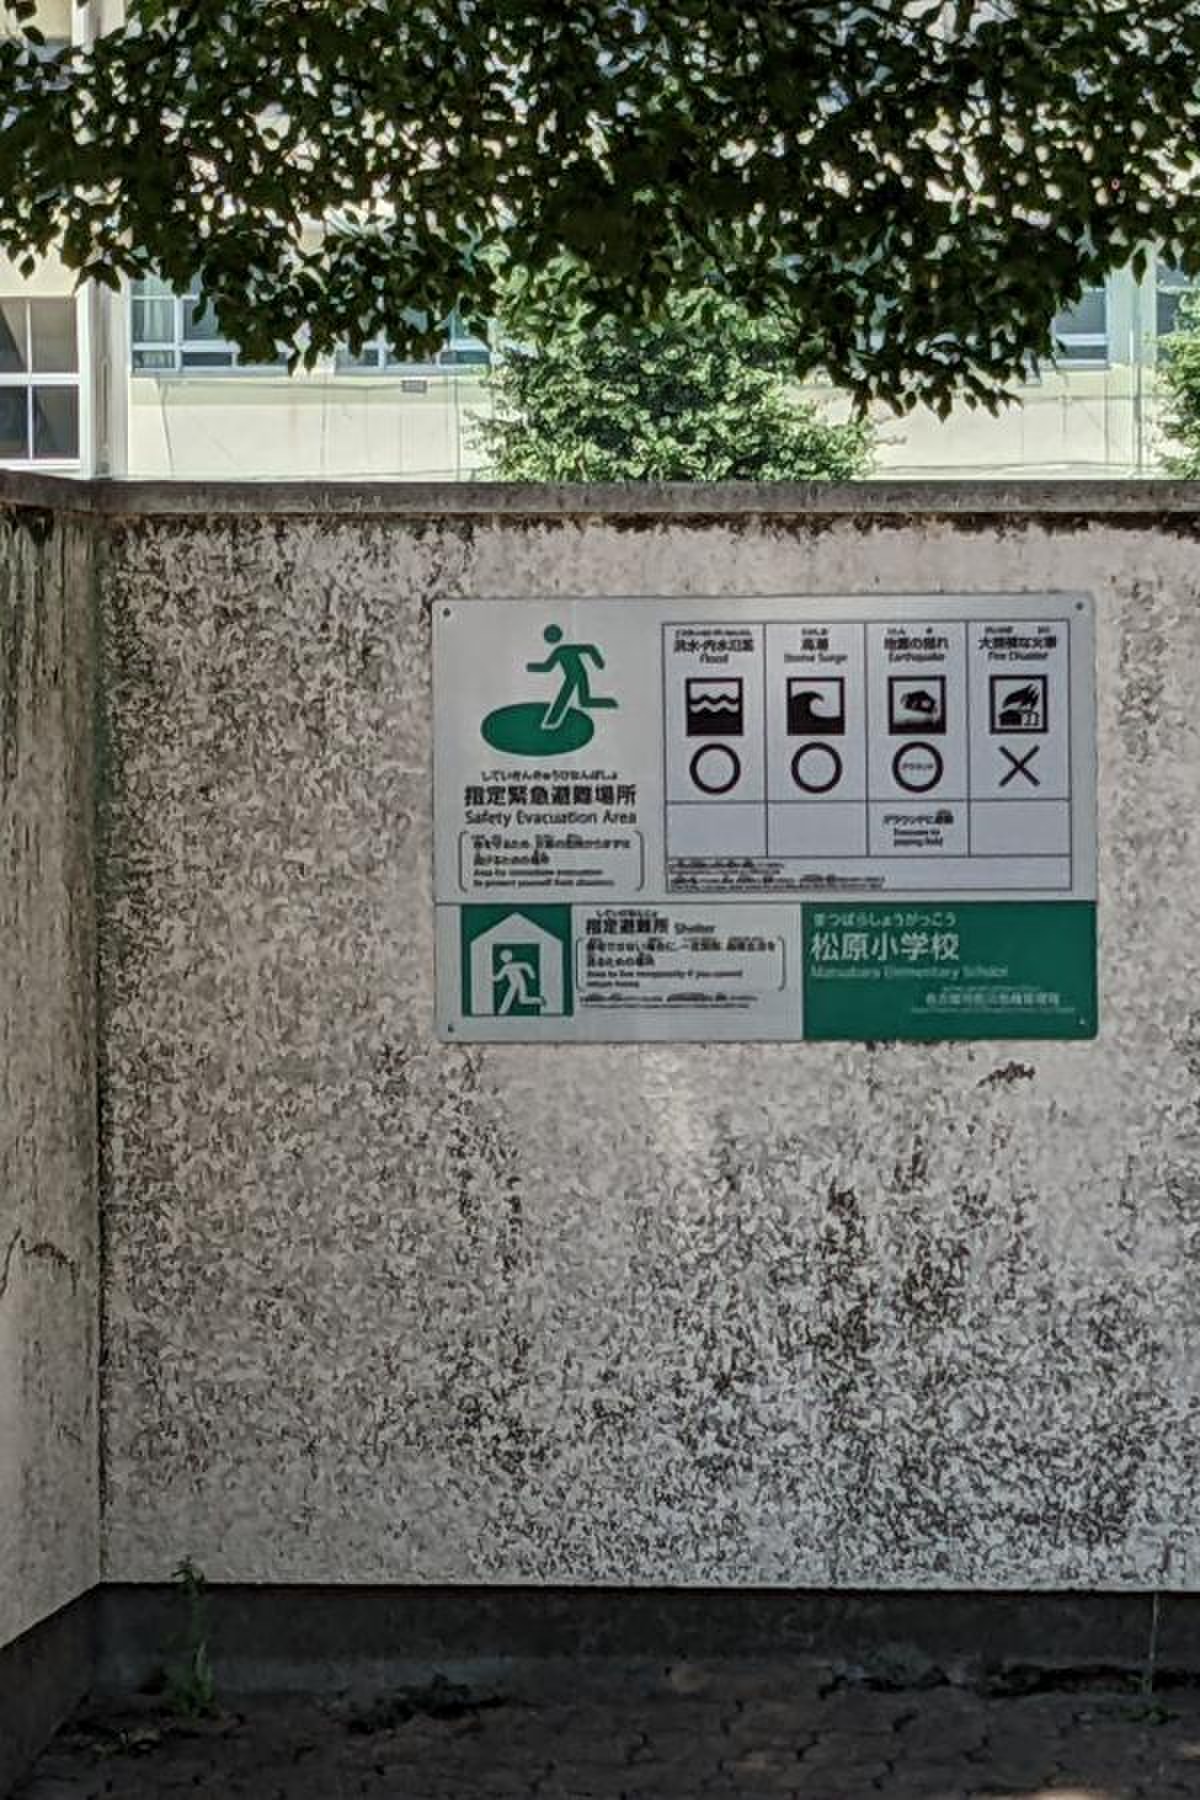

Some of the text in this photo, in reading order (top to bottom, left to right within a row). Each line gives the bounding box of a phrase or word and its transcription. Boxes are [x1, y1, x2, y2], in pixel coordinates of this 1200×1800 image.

[464, 784, 637, 806] 指定緊急避難場所
[464, 809, 637, 827] Safety Evacuation Area
[586, 918, 669, 934] 指定避難所
[813, 912, 957, 927] まつばらしょうがっこう
[810, 932, 960, 960] 松原小学校
